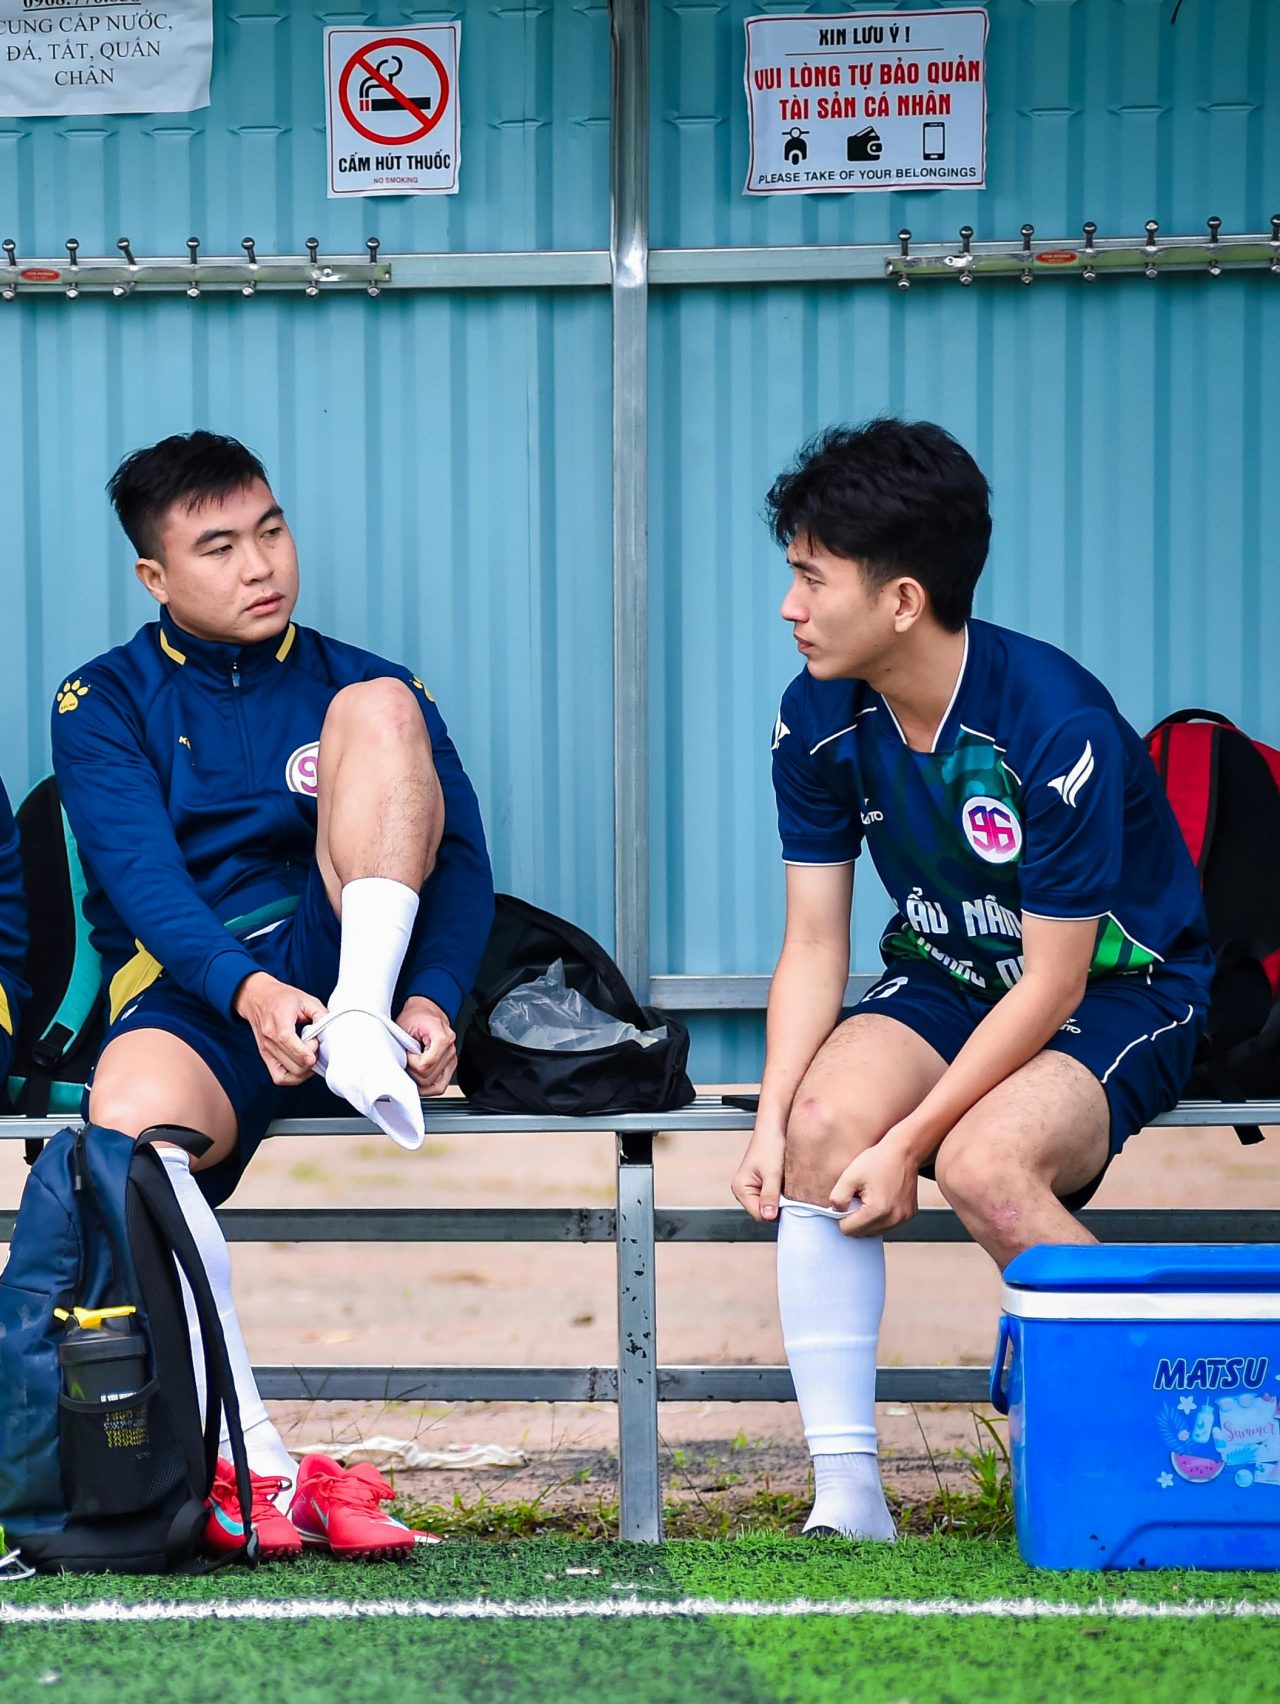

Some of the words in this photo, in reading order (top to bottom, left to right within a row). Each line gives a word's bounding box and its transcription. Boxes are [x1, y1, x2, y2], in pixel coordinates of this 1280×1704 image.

[106, 9, 173, 32] NƯỚC,
[818, 28, 847, 46] XIN
[853, 25, 884, 45] LƯU
[889, 22, 900, 43] Ý
[6, 40, 42, 62] ĐÁ,
[54, 65, 114, 86] CHÂN
[754, 67, 782, 91] VUI
[789, 62, 841, 88] LÒNG
[848, 62, 874, 91] TỰ
[880, 57, 919, 85] BẢO
[927, 54, 980, 84] QUẢN
[779, 94, 809, 120] TÀI
[817, 90, 856, 119] SẢN
[864, 91, 890, 118] CÁ
[897, 89, 951, 116] NHÂN
[338, 151, 371, 173] CẤM
[375, 152, 402, 171] HÚT
[406, 149, 451, 170] THUỐC
[385, 176, 419, 184] SMOKING
[758, 172, 800, 184] PLEASE
[804, 171, 835, 181] TAKE
[839, 170, 855, 180] OF
[859, 169, 892, 180] YOUR
[895, 167, 977, 178] BELONGINGS
[967, 804, 1017, 855] 96
[906, 886, 949, 934] ẨU
[1153, 1357, 1269, 1390] MATSU
